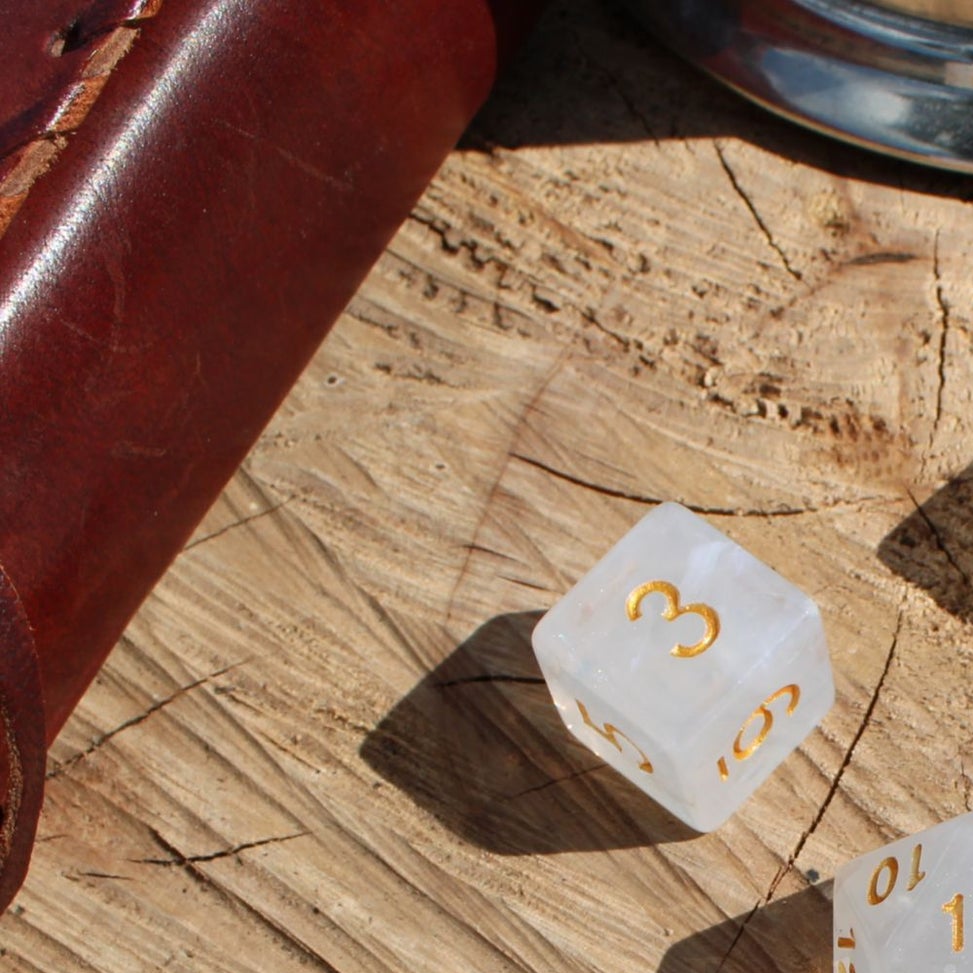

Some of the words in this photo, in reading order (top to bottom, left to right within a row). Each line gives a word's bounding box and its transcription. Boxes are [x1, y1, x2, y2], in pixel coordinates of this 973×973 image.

[625, 580, 721, 659] 3
[575, 698, 654, 774] 5
[867, 844, 926, 906] 10
